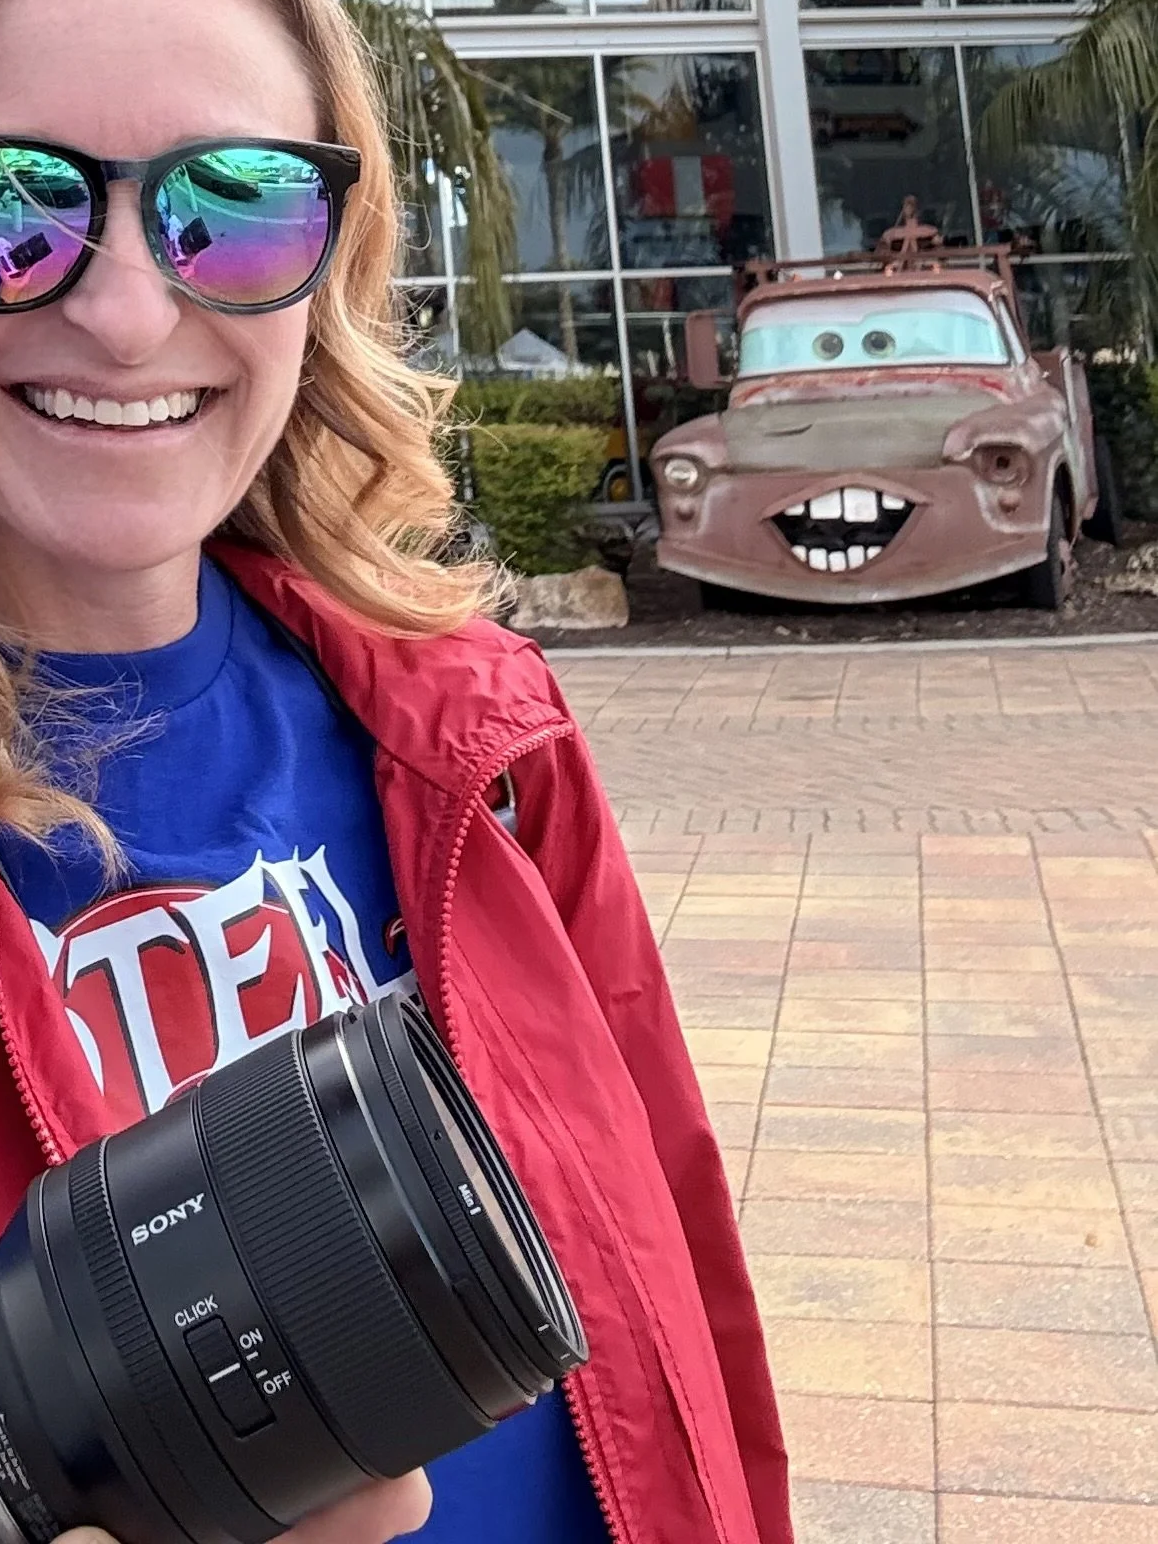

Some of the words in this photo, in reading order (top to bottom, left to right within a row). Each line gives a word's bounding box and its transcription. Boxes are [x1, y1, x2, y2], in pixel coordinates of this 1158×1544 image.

[457, 1183, 475, 1208] Min
[130, 1192, 205, 1246] SONY
[174, 1294, 219, 1328] CLICK
[239, 1328, 264, 1349] ON
[263, 1370, 292, 1395] OFF
